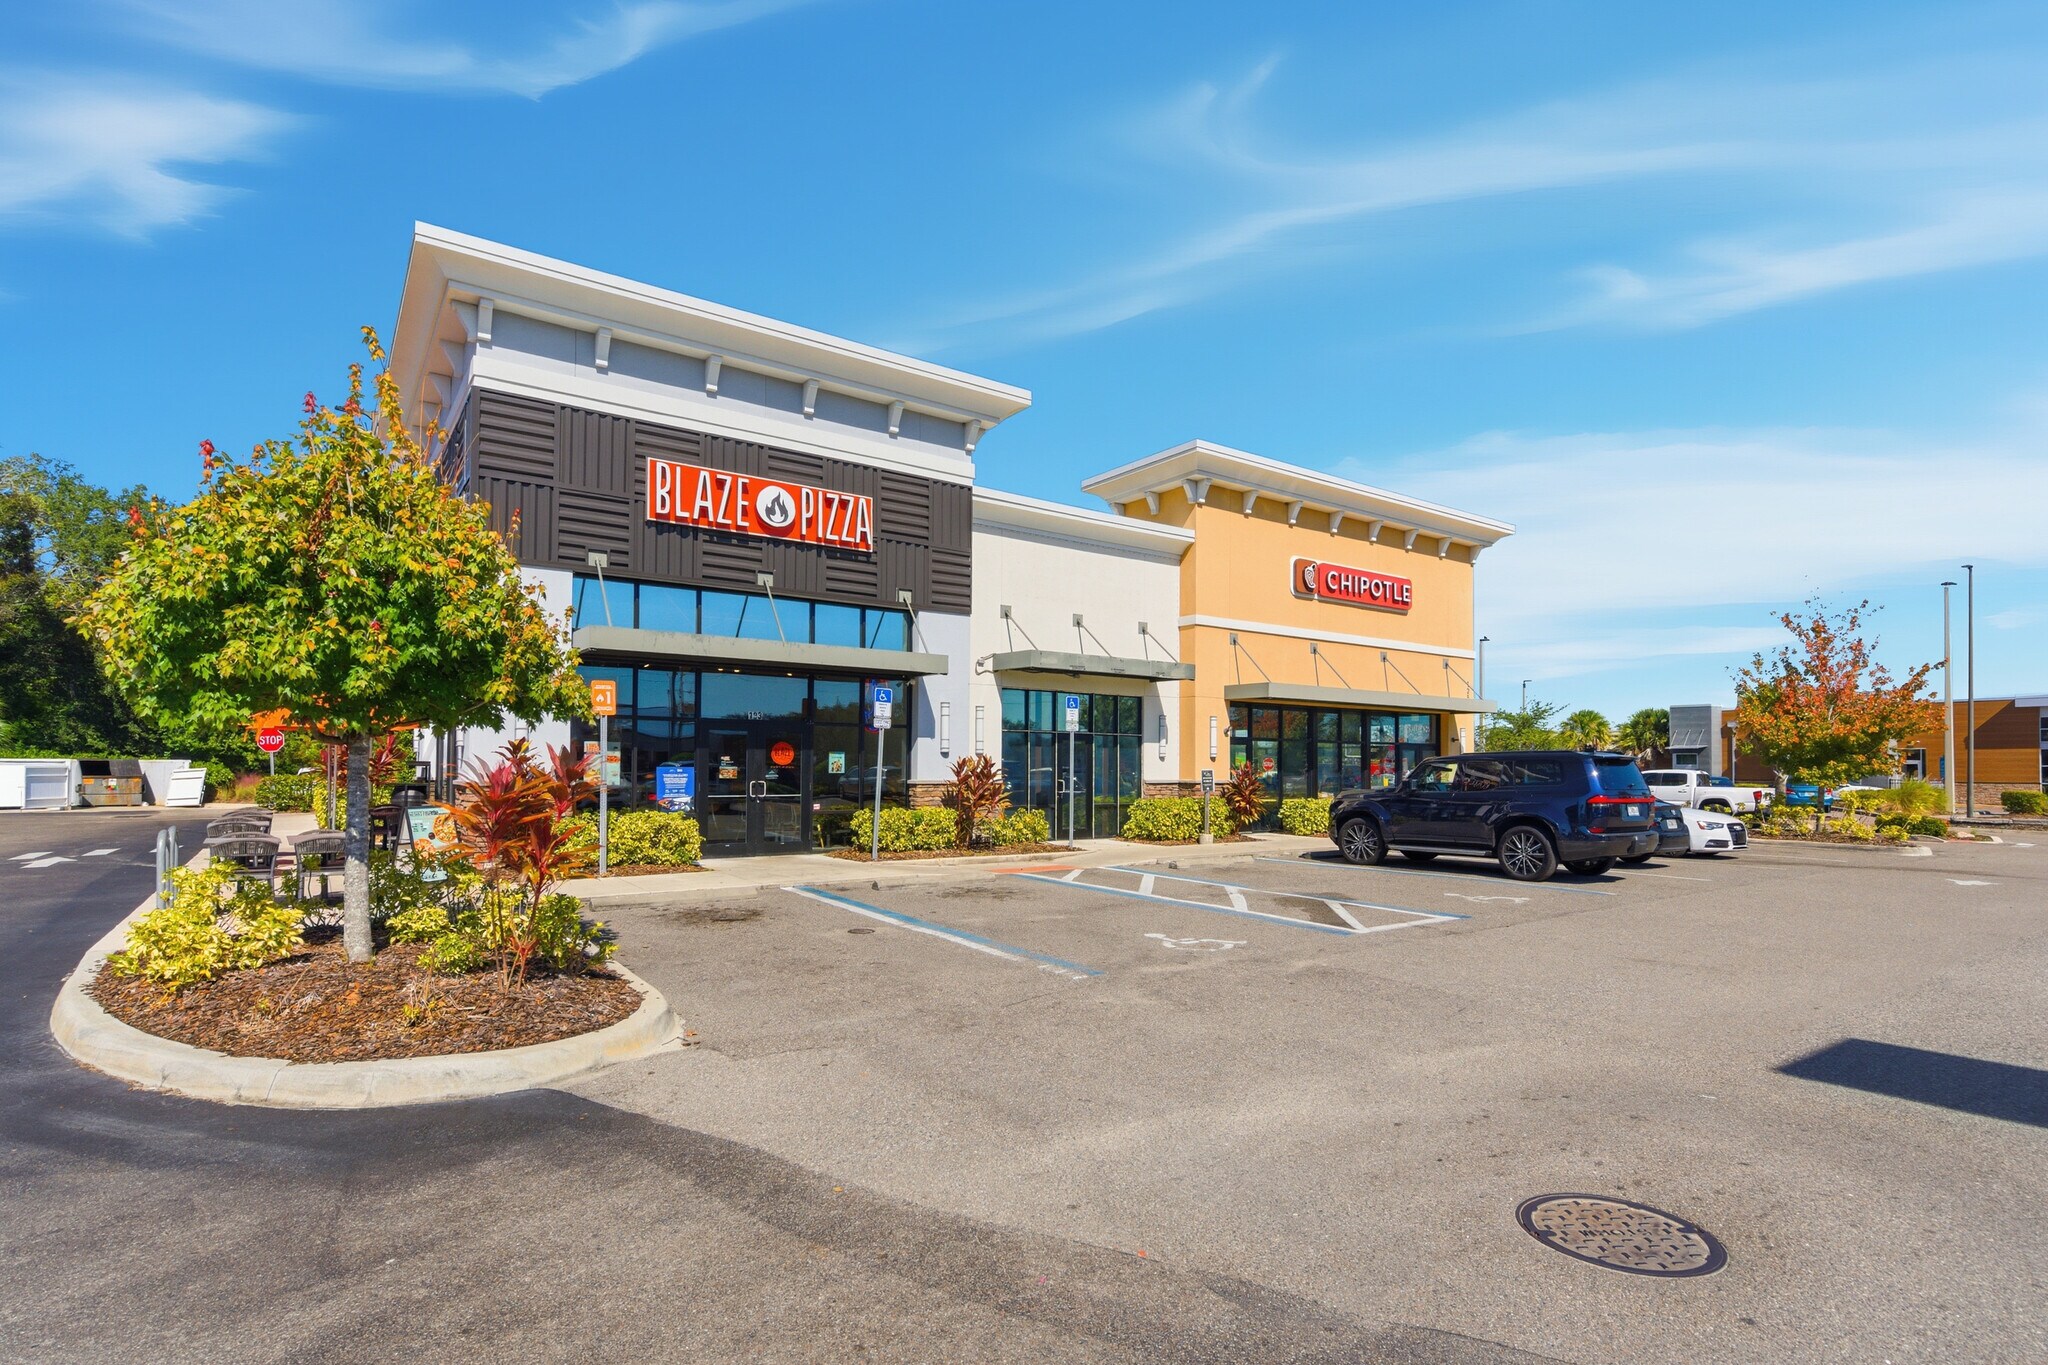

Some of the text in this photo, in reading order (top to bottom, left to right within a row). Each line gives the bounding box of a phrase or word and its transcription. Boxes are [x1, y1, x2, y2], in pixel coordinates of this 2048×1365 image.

[655, 461, 872, 545] BLAZE PIZZA
[1327, 571, 1411, 602] CHIPOTLE
[259, 735, 282, 745] STOP
